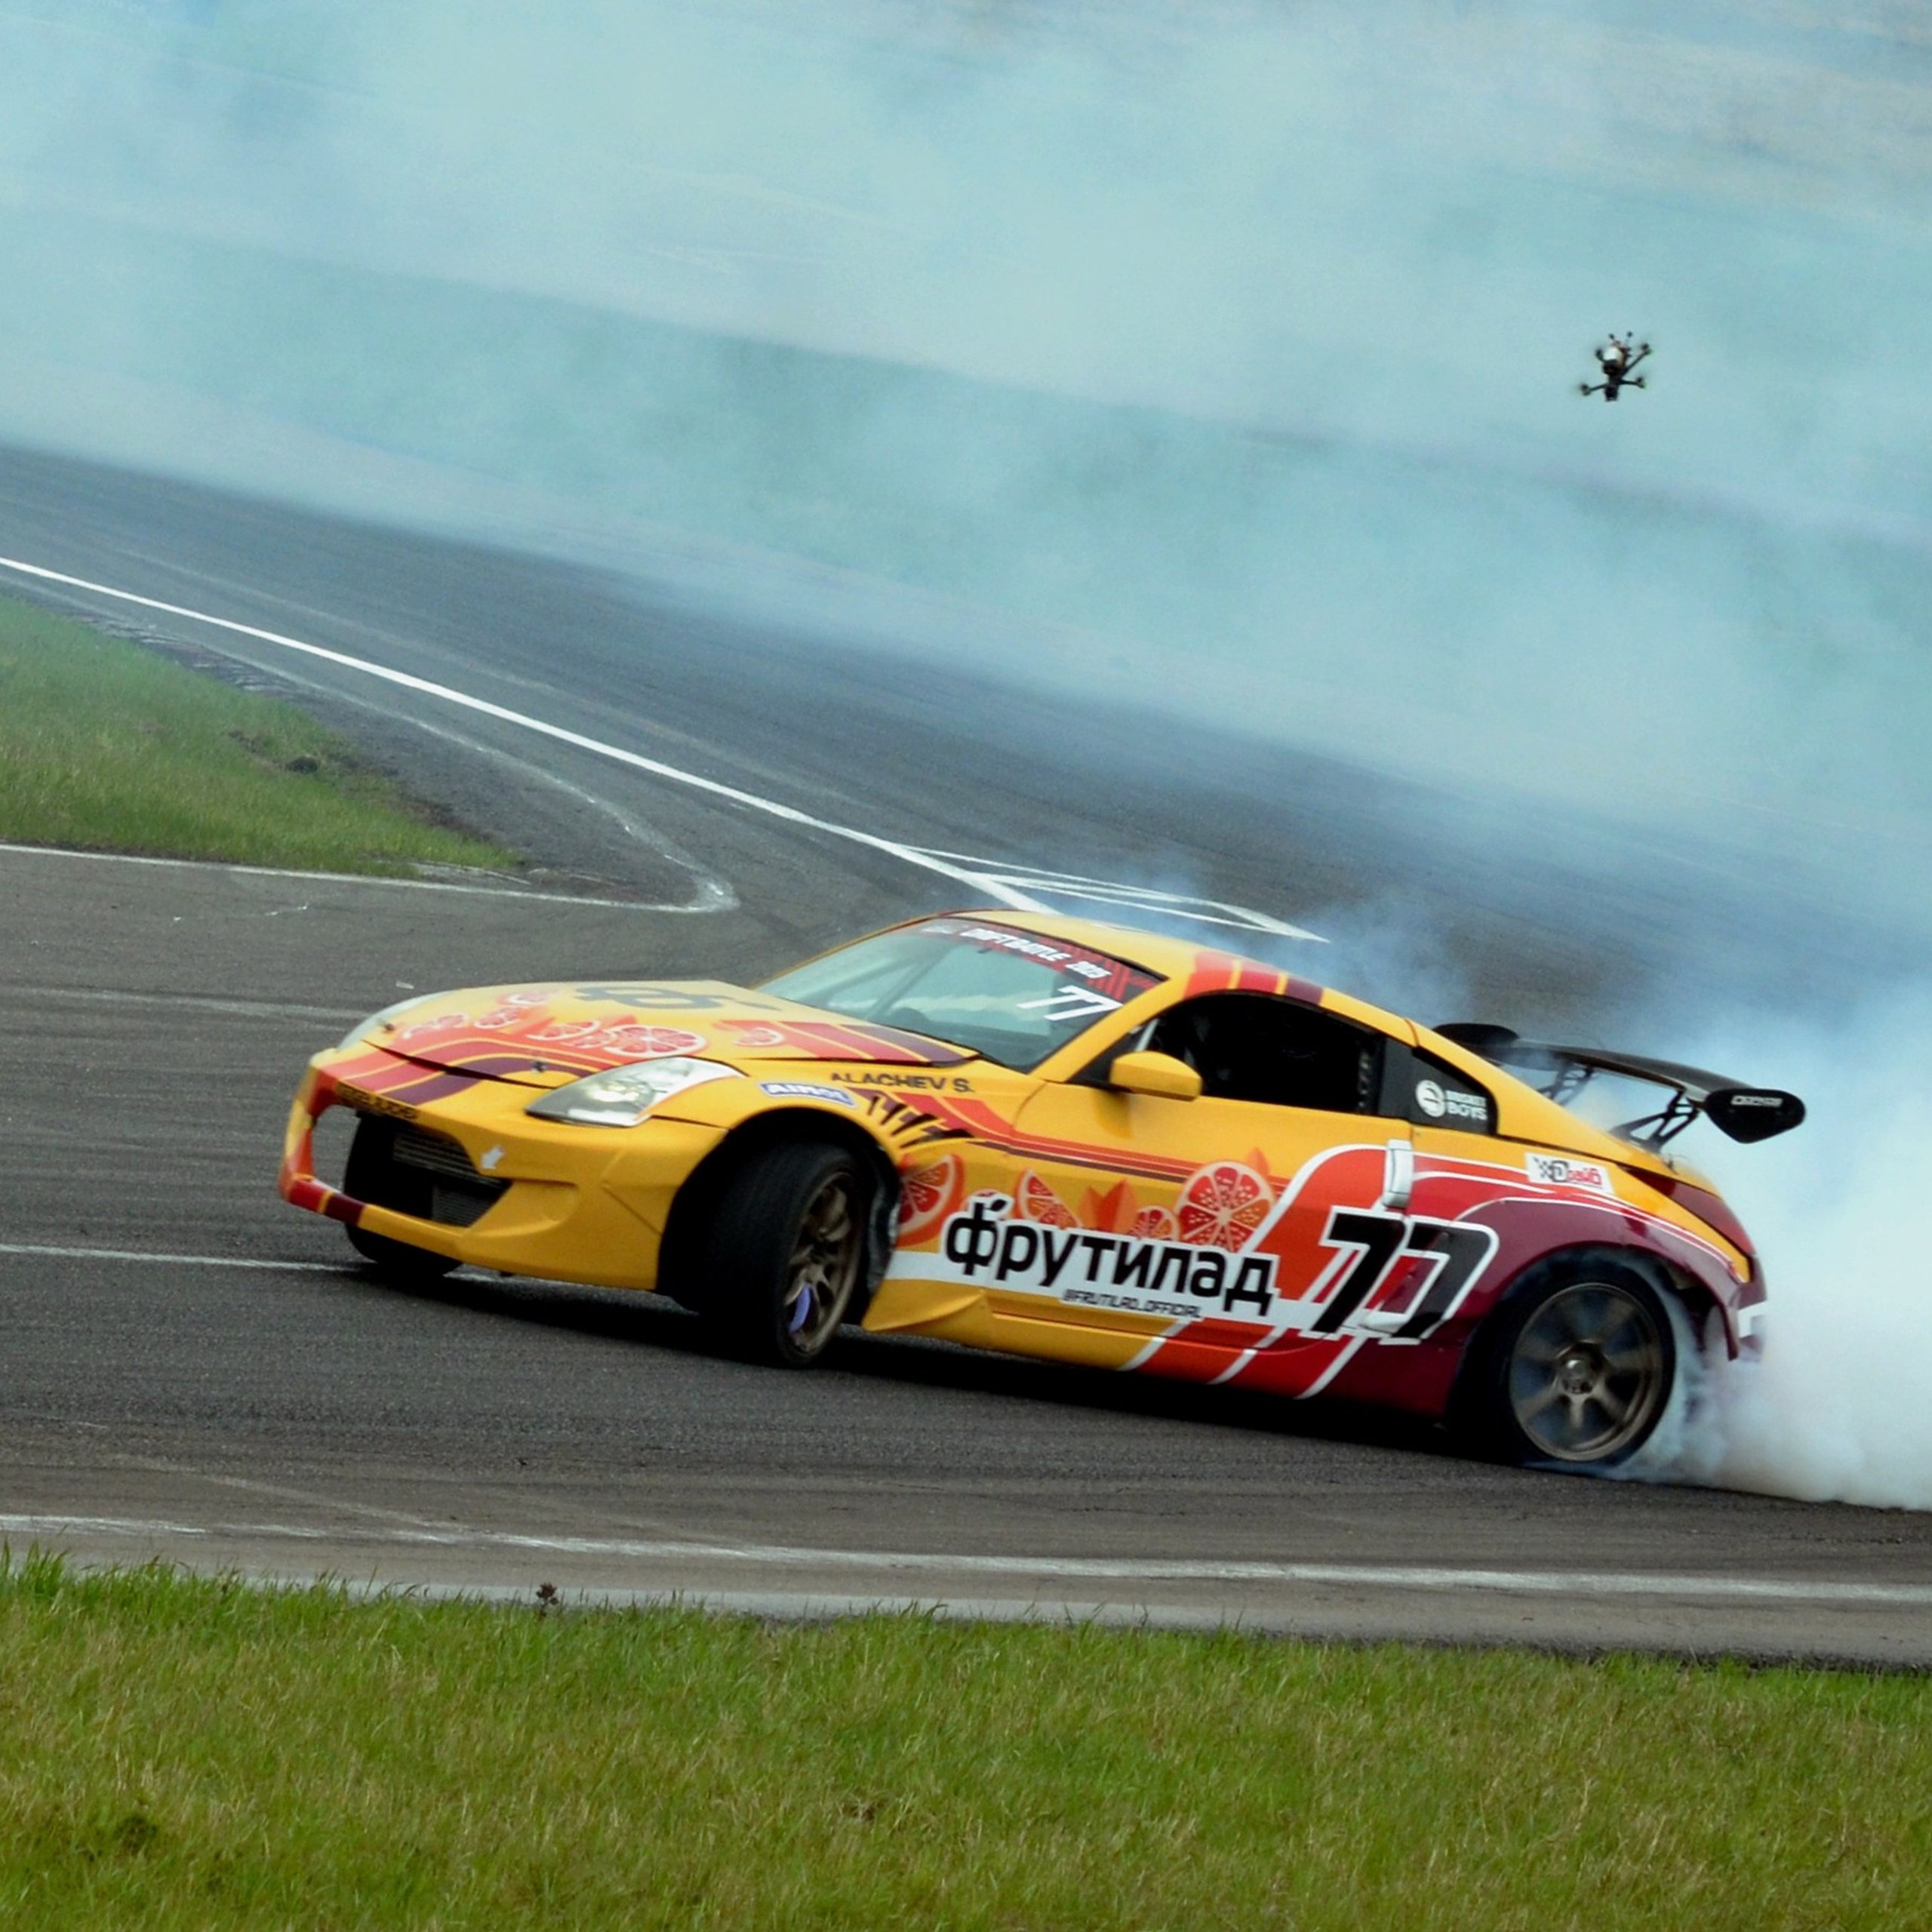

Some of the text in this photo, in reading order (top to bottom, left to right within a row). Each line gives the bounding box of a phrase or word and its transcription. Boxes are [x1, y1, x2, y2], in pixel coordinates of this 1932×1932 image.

[1017, 985, 1123, 1020] 77
[832, 1072, 946, 1090] ALACHEV
[1309, 1209, 1491, 1341] 77
